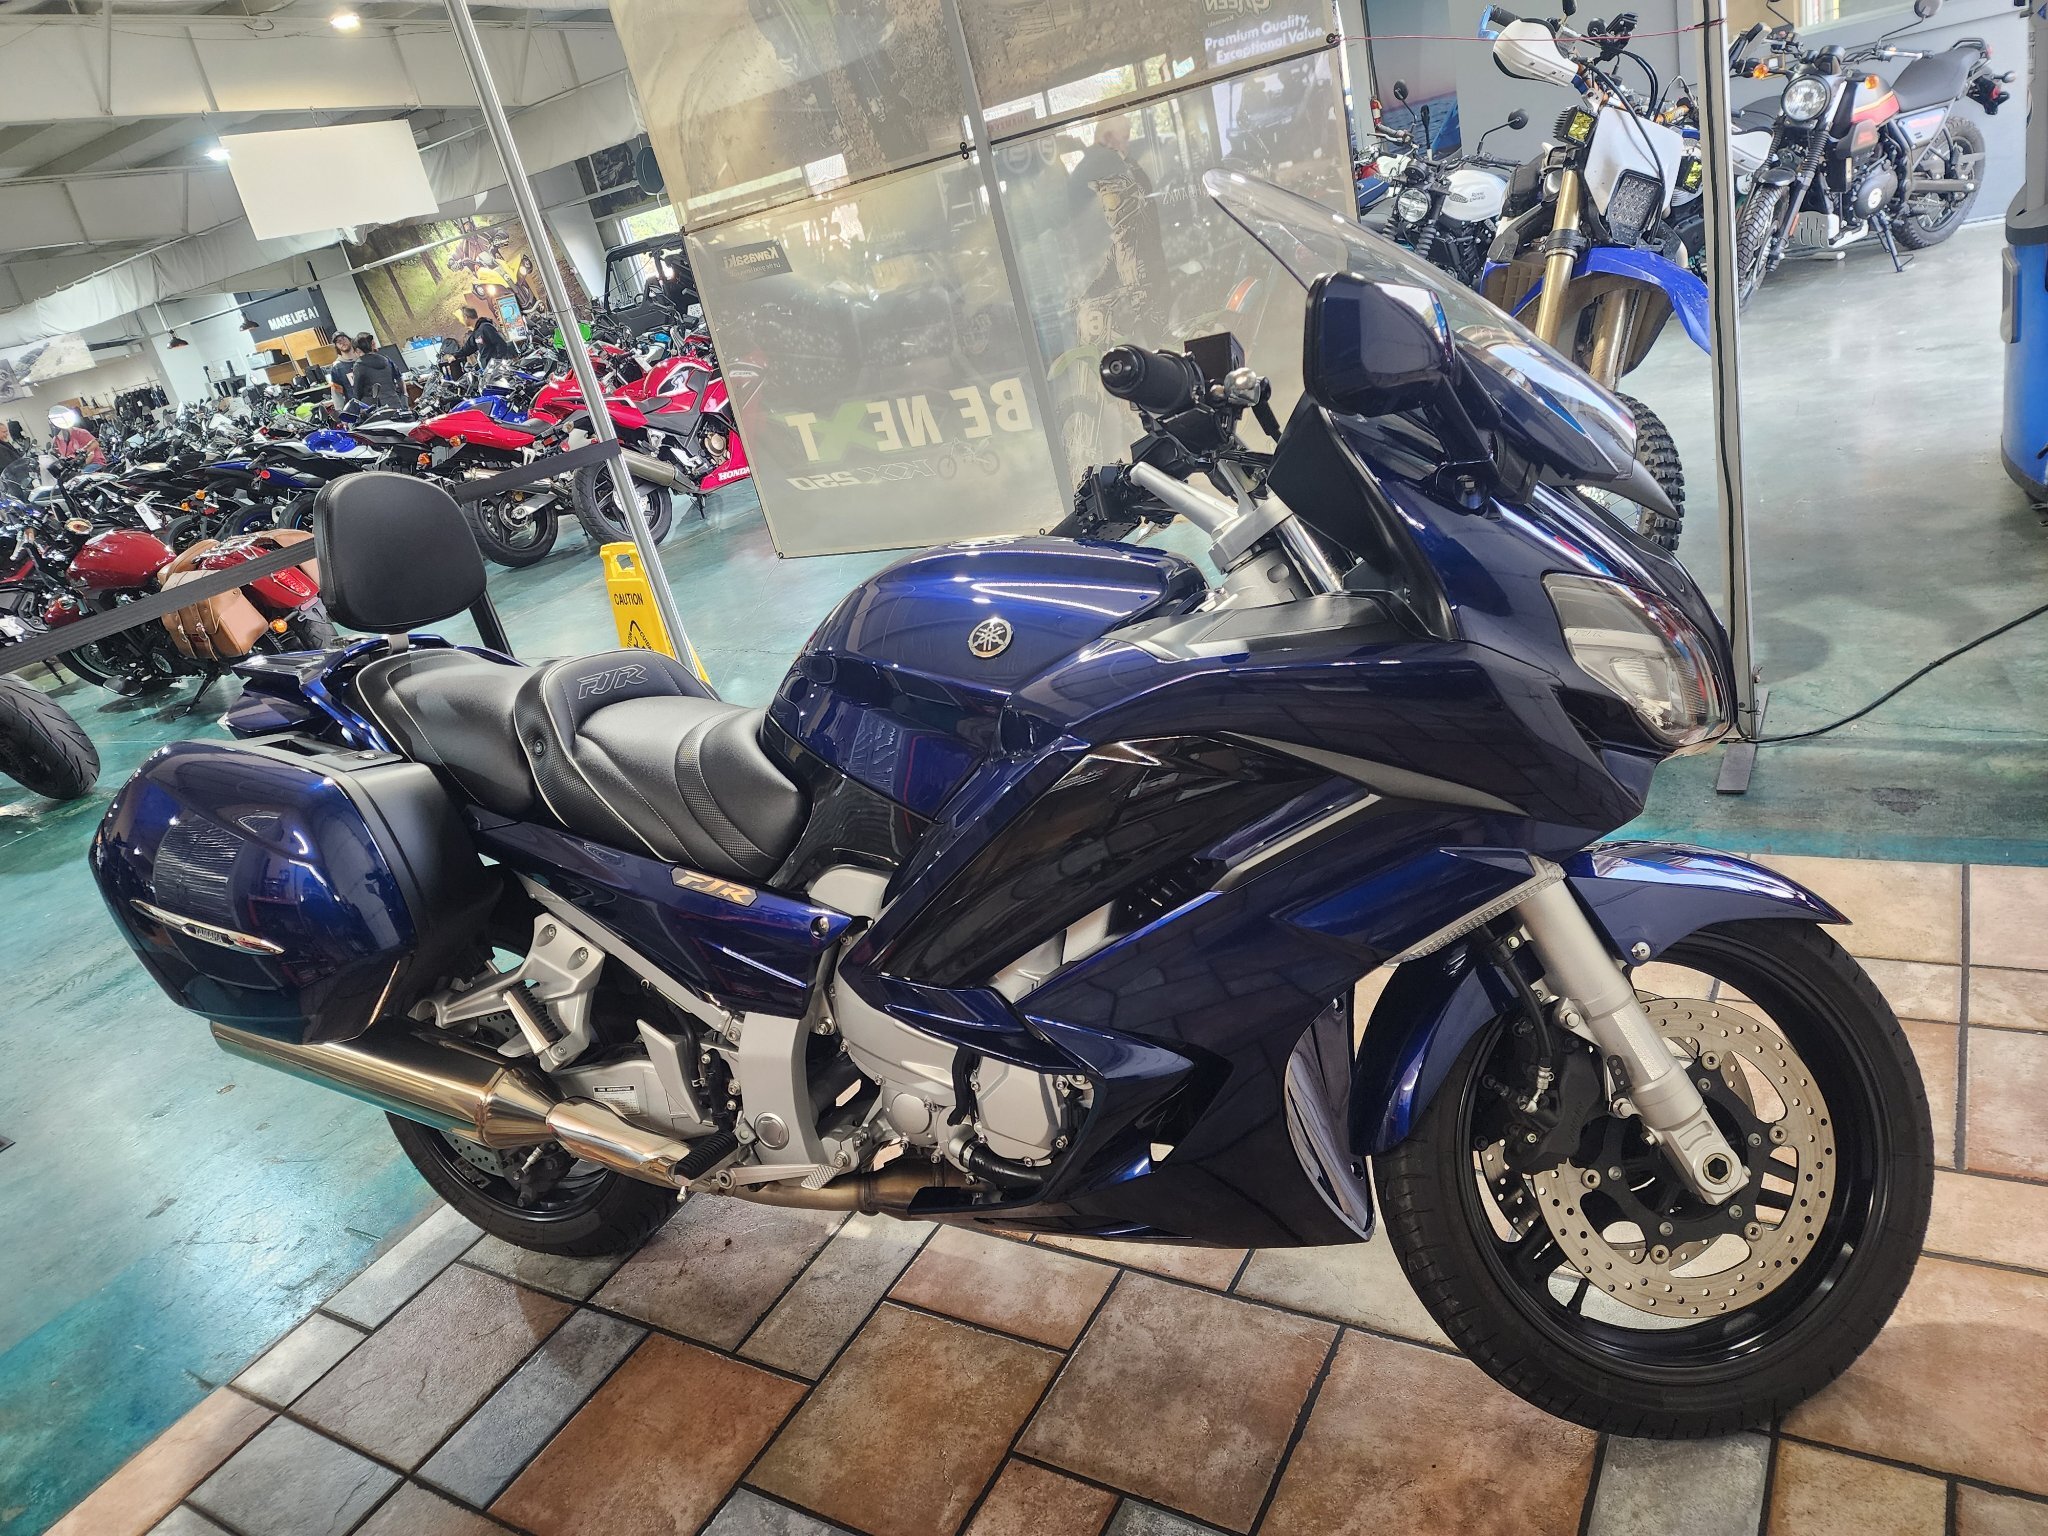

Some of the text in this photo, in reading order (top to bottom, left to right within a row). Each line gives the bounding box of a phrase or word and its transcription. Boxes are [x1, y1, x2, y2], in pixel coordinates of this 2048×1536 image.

[1204, 14, 1310, 50] Premium Quality.
[1216, 25, 1326, 64] Exceptional Value.
[267, 313, 293, 331] MAKE
[290, 309, 309, 325] LIFE
[307, 307, 316, 319] A
[718, 466, 751, 482] HONDA
[613, 593, 644, 606] CAUTION
[577, 664, 649, 699] FJR
[675, 869, 752, 904] FJR
[195, 926, 223, 943] YAMAHA
